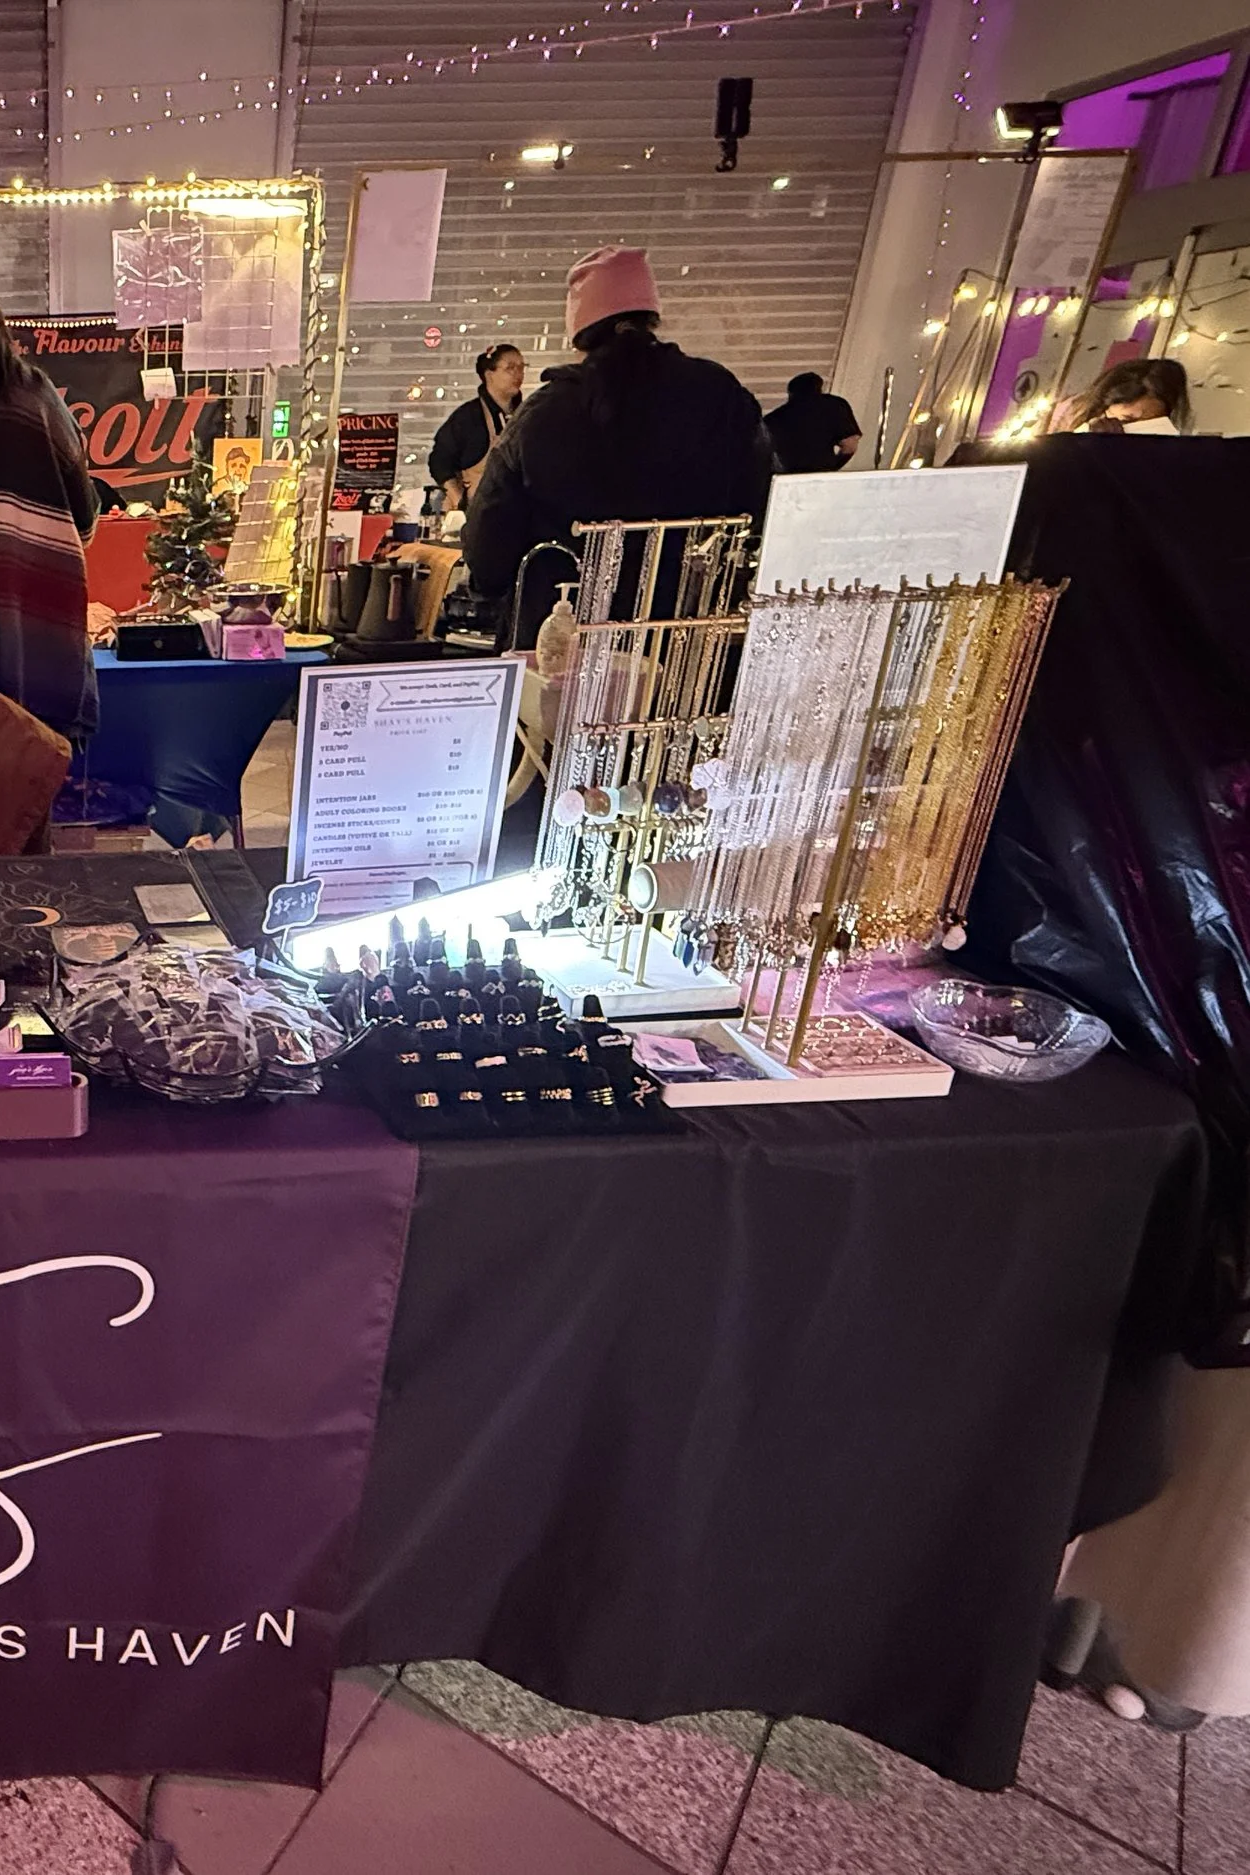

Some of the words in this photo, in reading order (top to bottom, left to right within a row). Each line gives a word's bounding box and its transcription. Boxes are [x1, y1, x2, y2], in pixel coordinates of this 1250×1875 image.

[33, 329, 126, 355] Flavour
[338, 415, 398, 431] PRICING
[415, 716, 453, 724] HAVEN
[333, 730, 352, 738] PayPal
[320, 744, 349, 752] YES/NO
[325, 757, 347, 765] CARD
[347, 756, 366, 764] PULL
[346, 769, 365, 777] PULL
[316, 795, 358, 804] INTENTION
[359, 794, 376, 802] JARS
[315, 808, 340, 816] ADULT
[340, 806, 381, 816] COLORING
[381, 805, 407, 813] BOOKS
[314, 820, 346, 829] INCENSE
[313, 832, 346, 842] CANDLES
[378, 830, 390, 838] OR
[311, 846, 353, 854] INTENTION
[311, 858, 344, 867] JEWELRY
[66, 1608, 296, 1667] HAVEN
